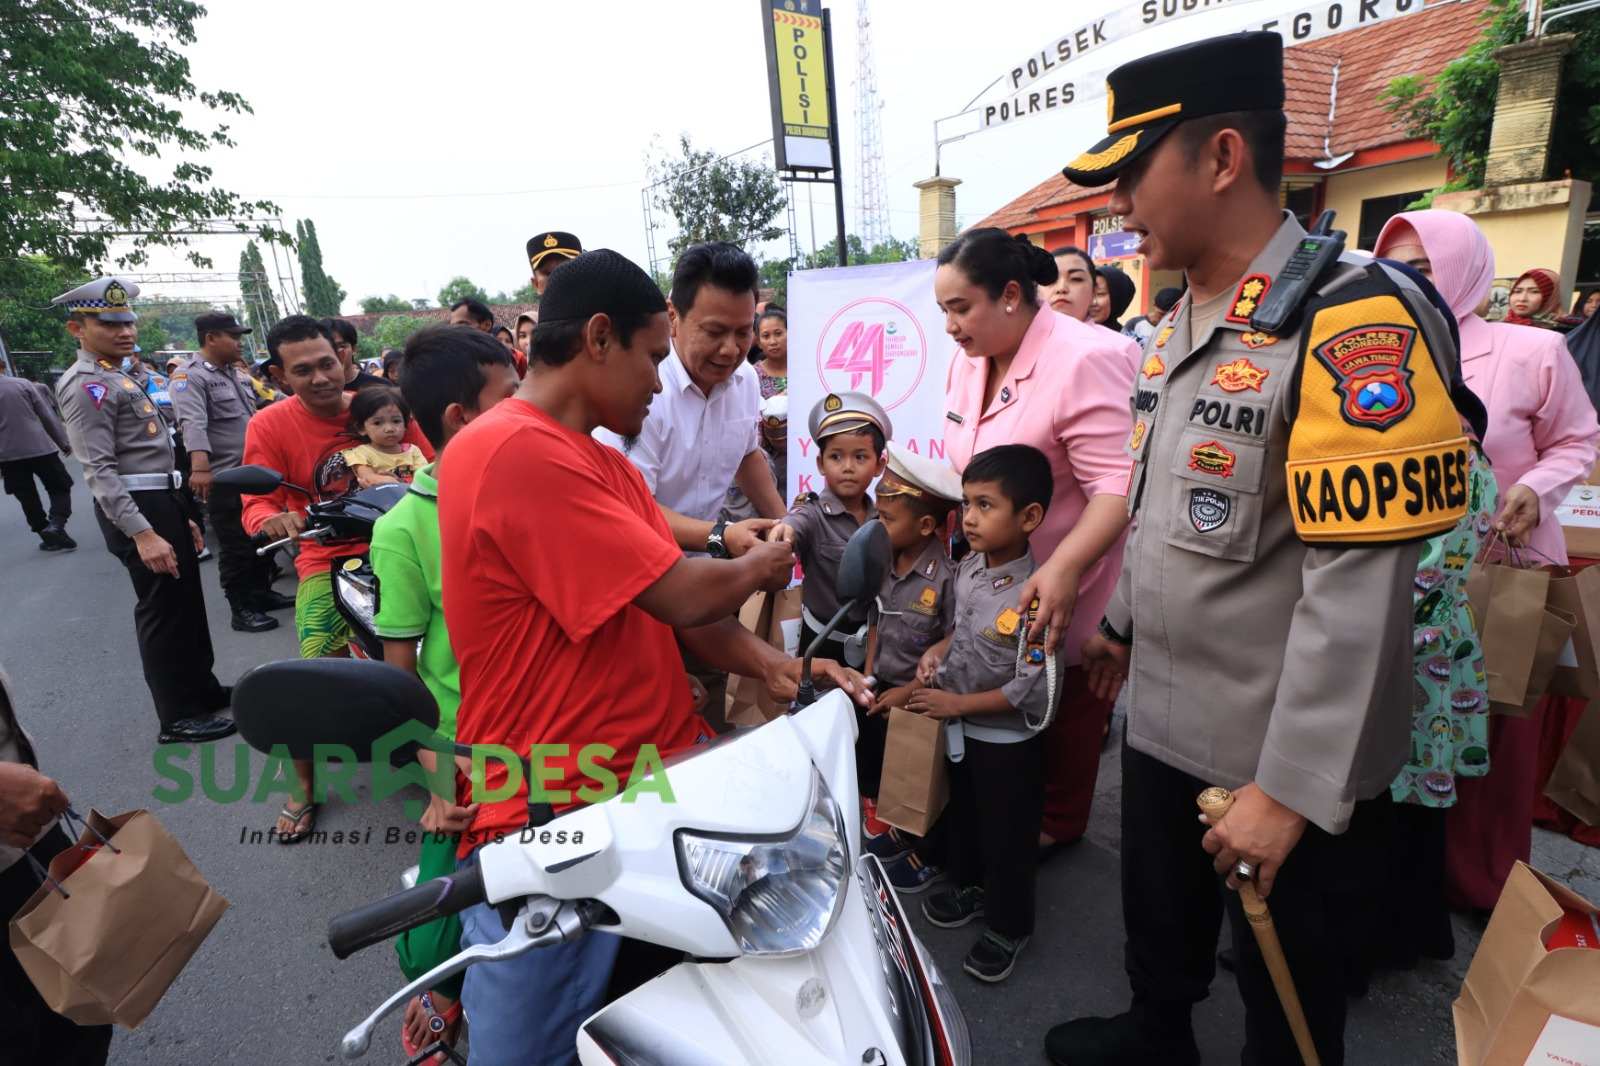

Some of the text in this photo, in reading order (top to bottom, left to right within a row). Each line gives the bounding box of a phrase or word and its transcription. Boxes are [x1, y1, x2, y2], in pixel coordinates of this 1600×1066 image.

[793, 28, 810, 123] POLISI
[1012, 20, 1107, 88] POLSEK
[986, 82, 1075, 126] POLRES
[1344, 354, 1369, 370] JAWA
[1189, 398, 1265, 436] POLRI
[1295, 449, 1466, 524] KAOPSRES
